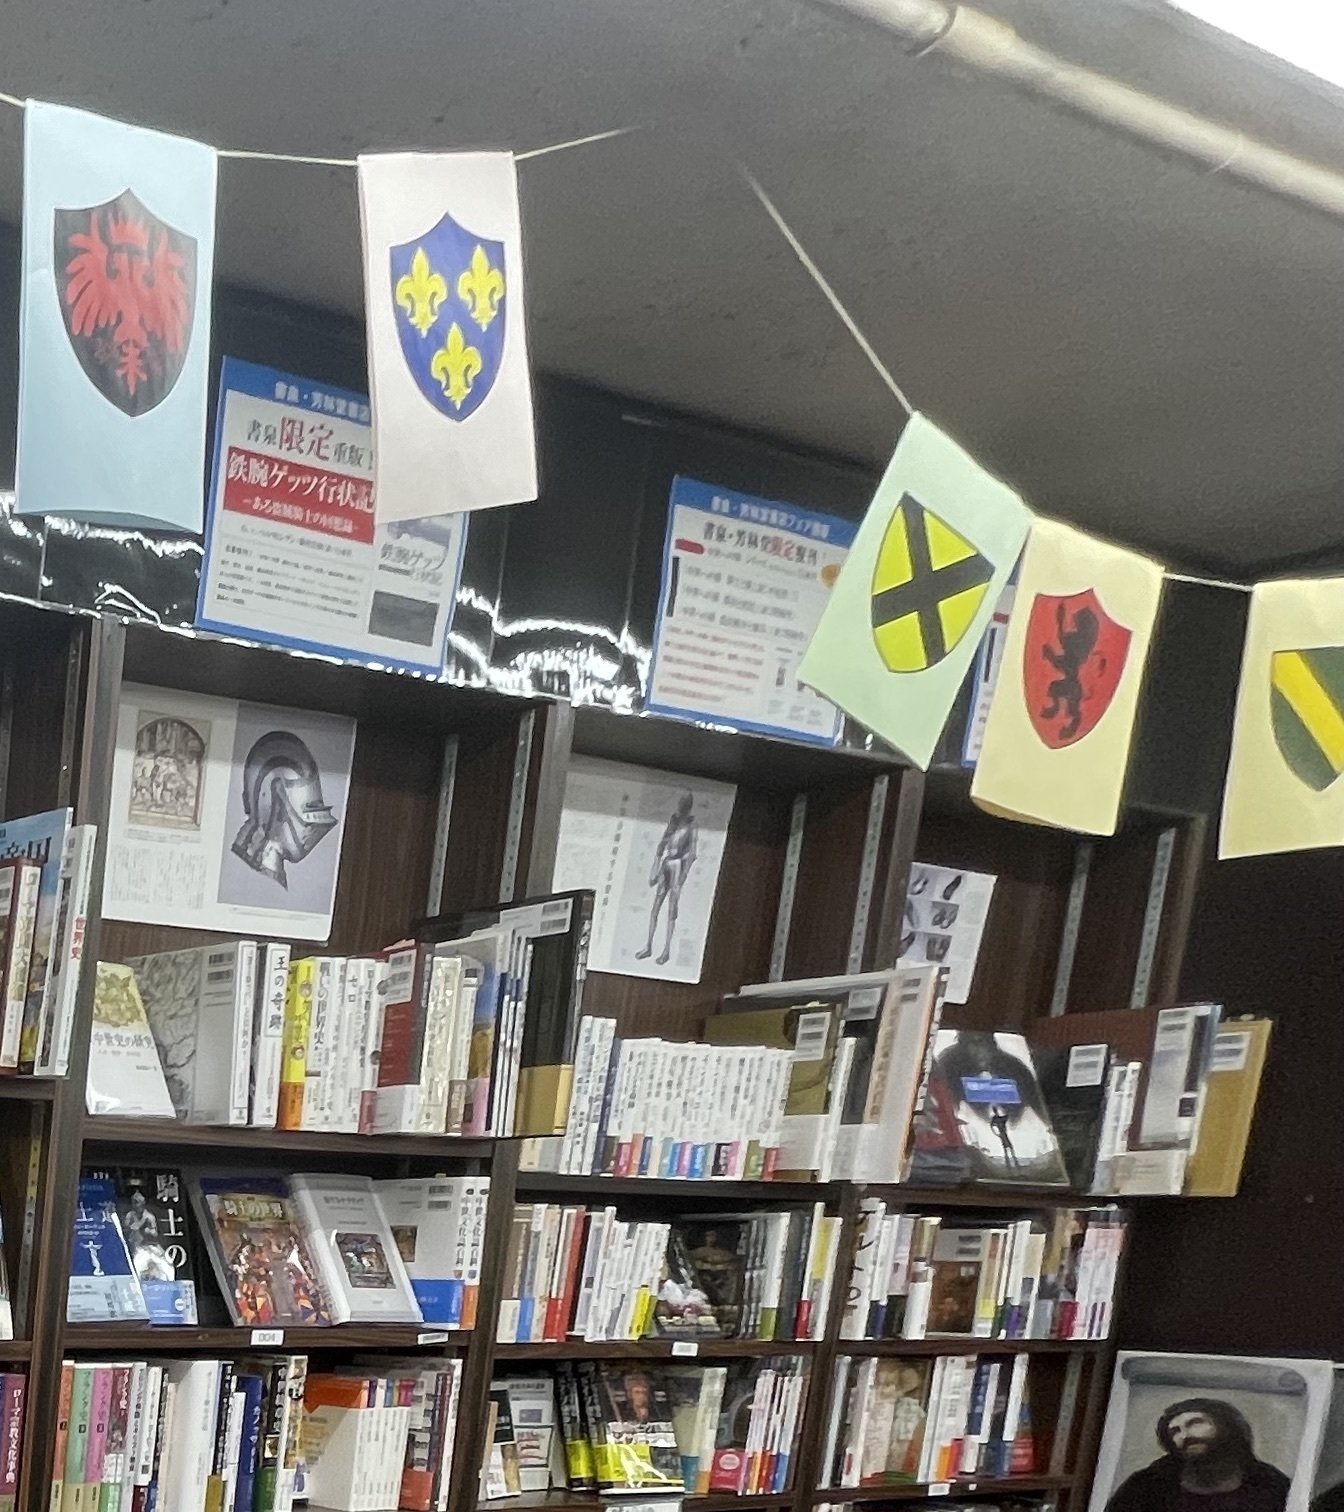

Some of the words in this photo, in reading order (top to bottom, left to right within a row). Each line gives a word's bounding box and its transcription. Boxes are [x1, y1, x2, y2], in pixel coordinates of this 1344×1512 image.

[71, 916, 86, 961] 世界史
[155, 1174, 188, 1269] 騎士の
